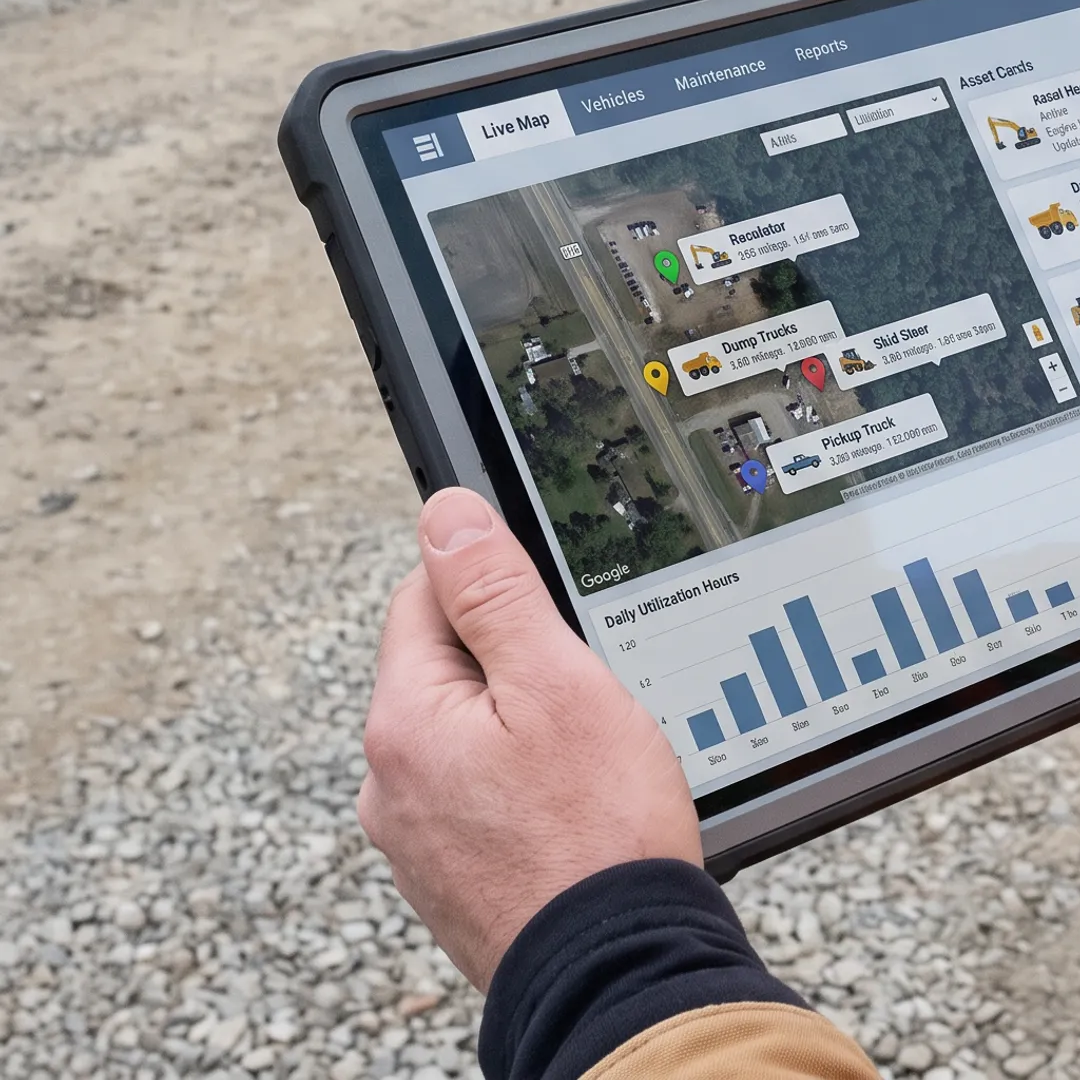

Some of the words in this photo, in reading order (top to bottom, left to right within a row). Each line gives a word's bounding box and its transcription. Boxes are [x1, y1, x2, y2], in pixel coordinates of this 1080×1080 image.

[795, 39, 848, 62] Reports
[674, 60, 767, 91] Maintenance
[957, 69, 996, 90] Asset
[580, 89, 645, 114] Vehicles
[481, 122, 515, 139] Live
[516, 113, 550, 131] Map
[722, 337, 757, 355] Dump
[757, 323, 798, 343] Trucks
[821, 430, 862, 450] Pickup
[862, 416, 896, 436] Truck
[580, 563, 630, 588] Google
[604, 608, 636, 629] Daily
[637, 586, 701, 616] Utilization
[702, 571, 740, 593] Hours
